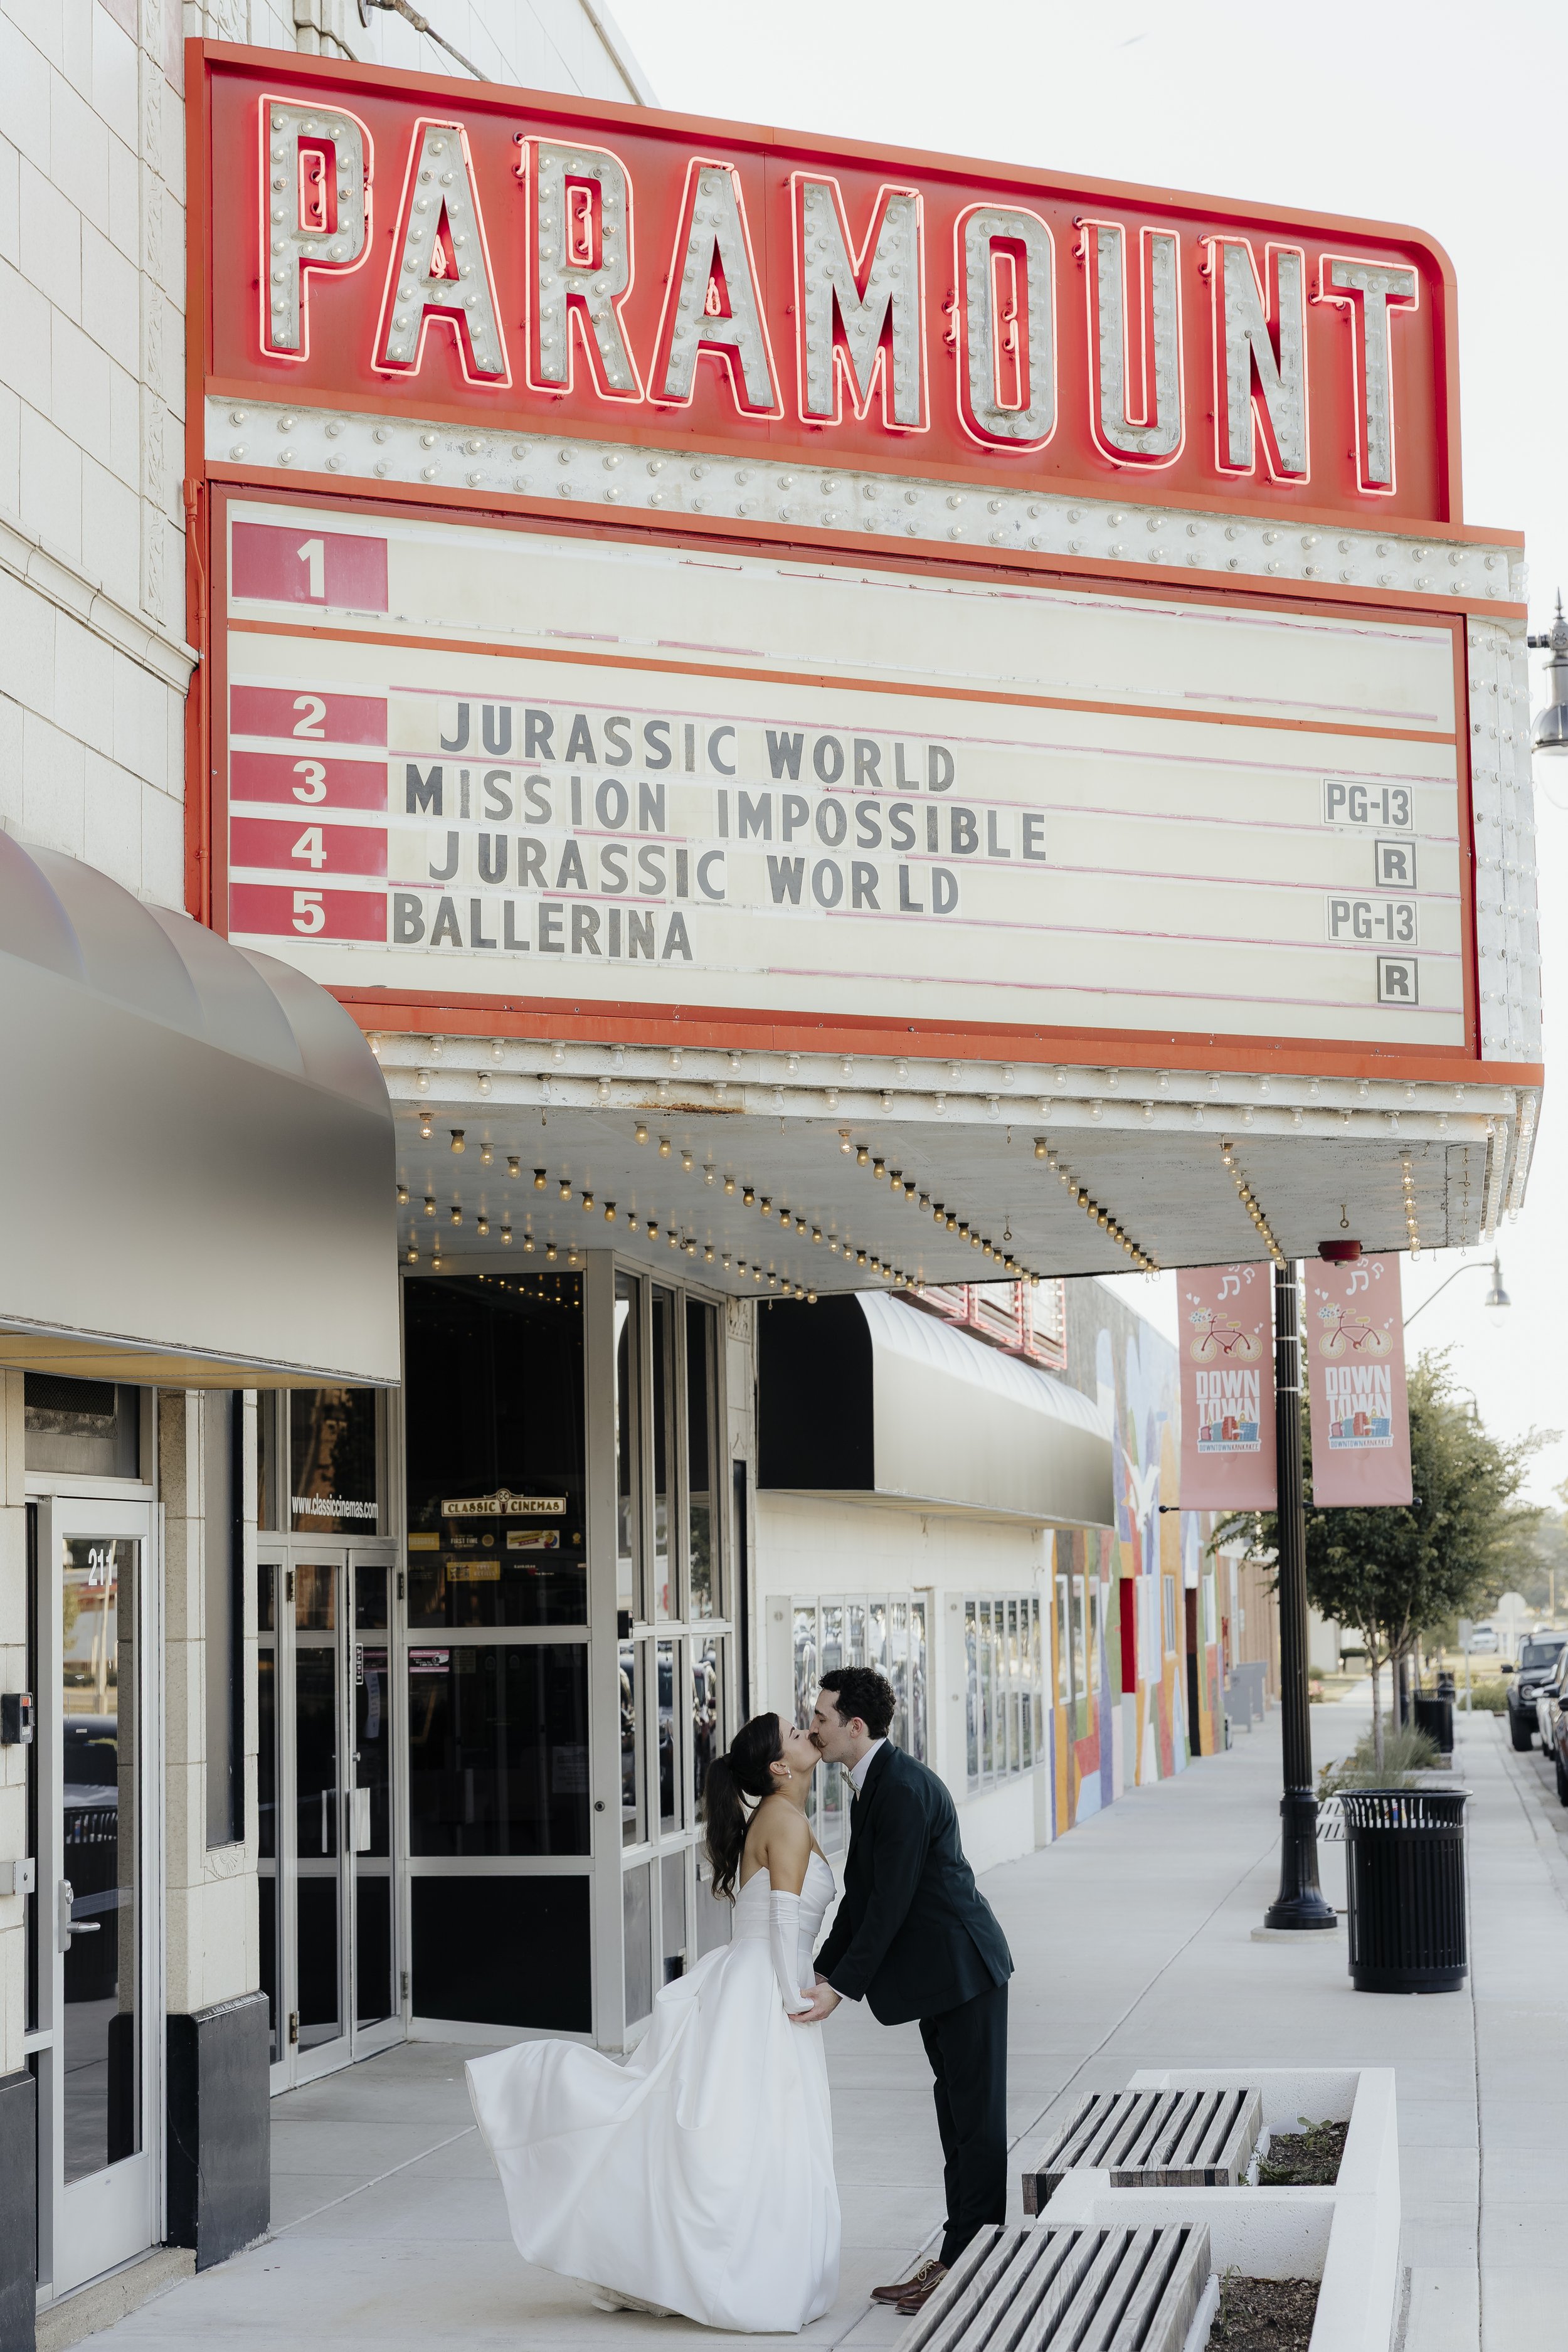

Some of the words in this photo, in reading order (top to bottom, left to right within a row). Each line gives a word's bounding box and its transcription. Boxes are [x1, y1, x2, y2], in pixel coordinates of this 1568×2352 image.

[258, 93, 1419, 495] PARAMOUNT
[297, 538, 325, 598] 1
[293, 696, 327, 738] 2
[440, 702, 736, 775] JURASSIC
[765, 729, 955, 792] WORLD
[292, 760, 327, 803] 3
[406, 763, 666, 833] MISSION
[718, 788, 1046, 861] IMPOSSIBLE
[1327, 783, 1409, 825] PG-13
[291, 827, 327, 869] 4
[1383, 849, 1407, 880] R
[429, 830, 725, 900] JURASSIC
[766, 854, 959, 914] WORLD
[292, 891, 326, 934] 5
[393, 893, 693, 961] BALLERINA
[1331, 900, 1414, 941] PG-13
[1385, 965, 1409, 996] R
[1196, 1370, 1260, 1399] DOWN
[1325, 1365, 1391, 1396] DOWN
[1197, 1398, 1261, 1428] TOWN
[1327, 1393, 1392, 1423] TOWN
[292, 1493, 379, 1518] www.classiccinemas.com
[448, 1501, 496, 1513] CLASSIC
[511, 1500, 560, 1512] CINEMAS
[88, 1548, 112, 1586] 211
